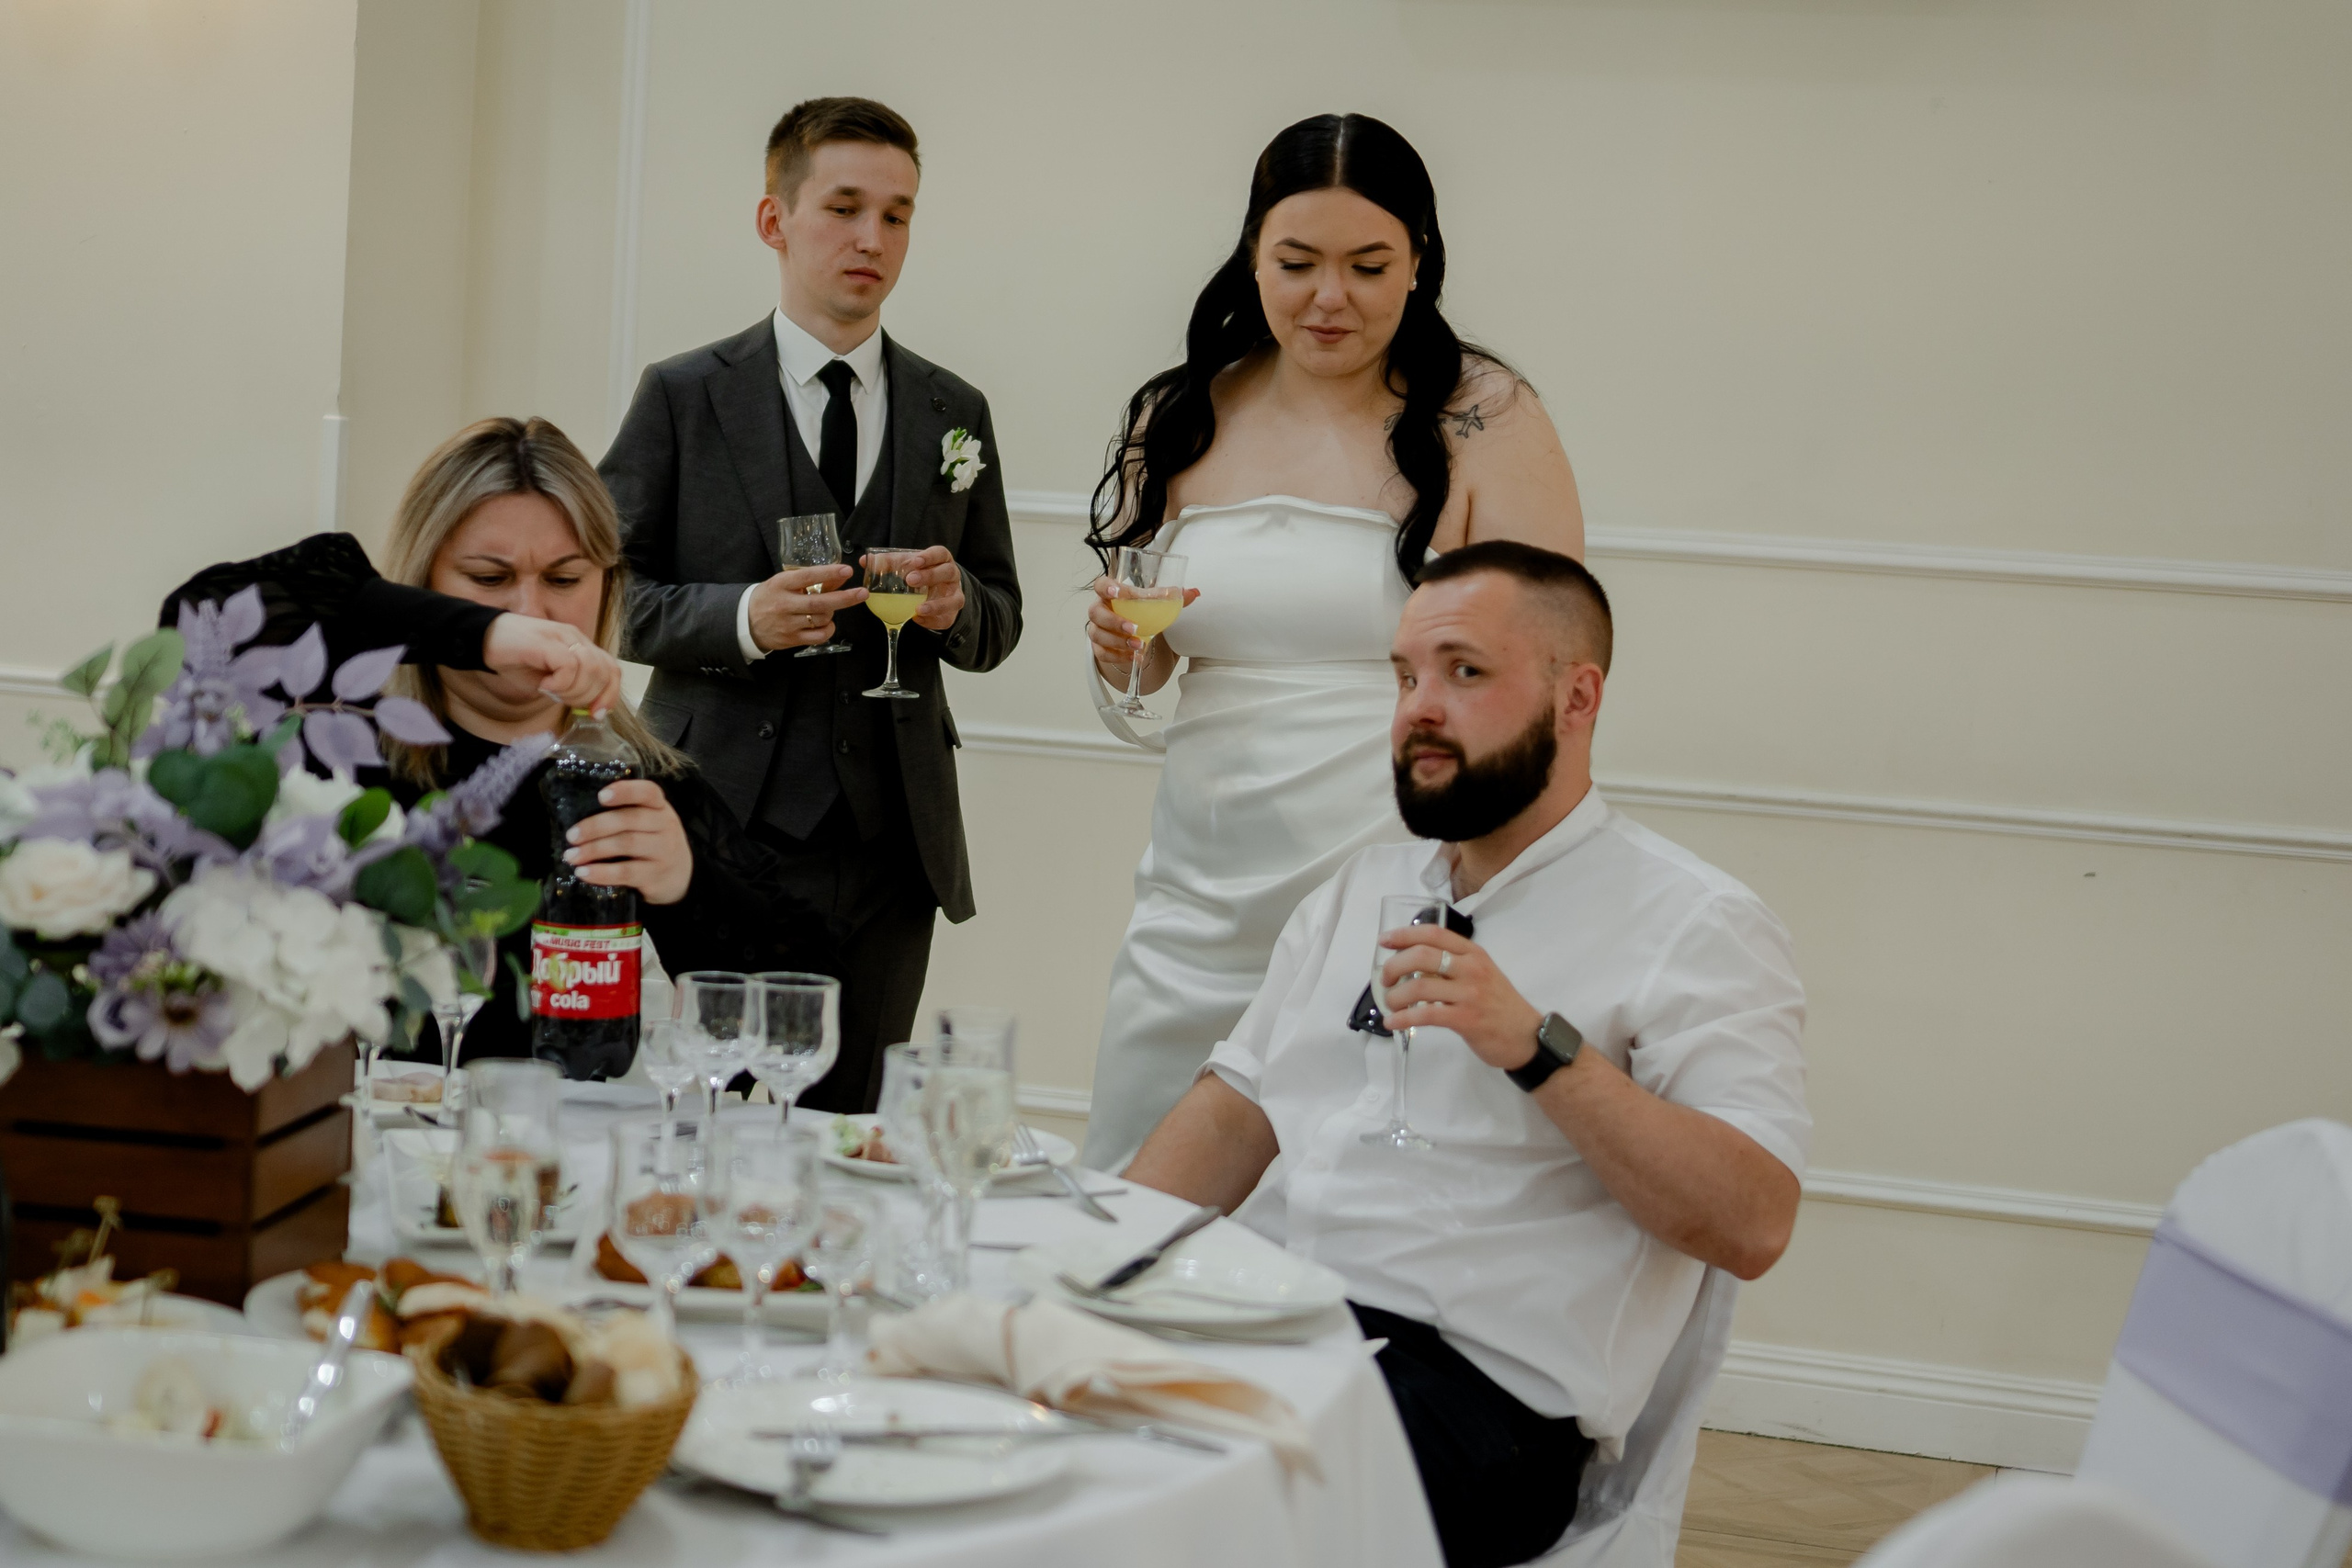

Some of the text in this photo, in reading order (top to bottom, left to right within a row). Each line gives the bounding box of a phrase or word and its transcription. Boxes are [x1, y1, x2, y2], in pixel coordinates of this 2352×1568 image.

[550, 937, 611, 949] MUSIC FEST
[549, 990, 590, 1010] cola
